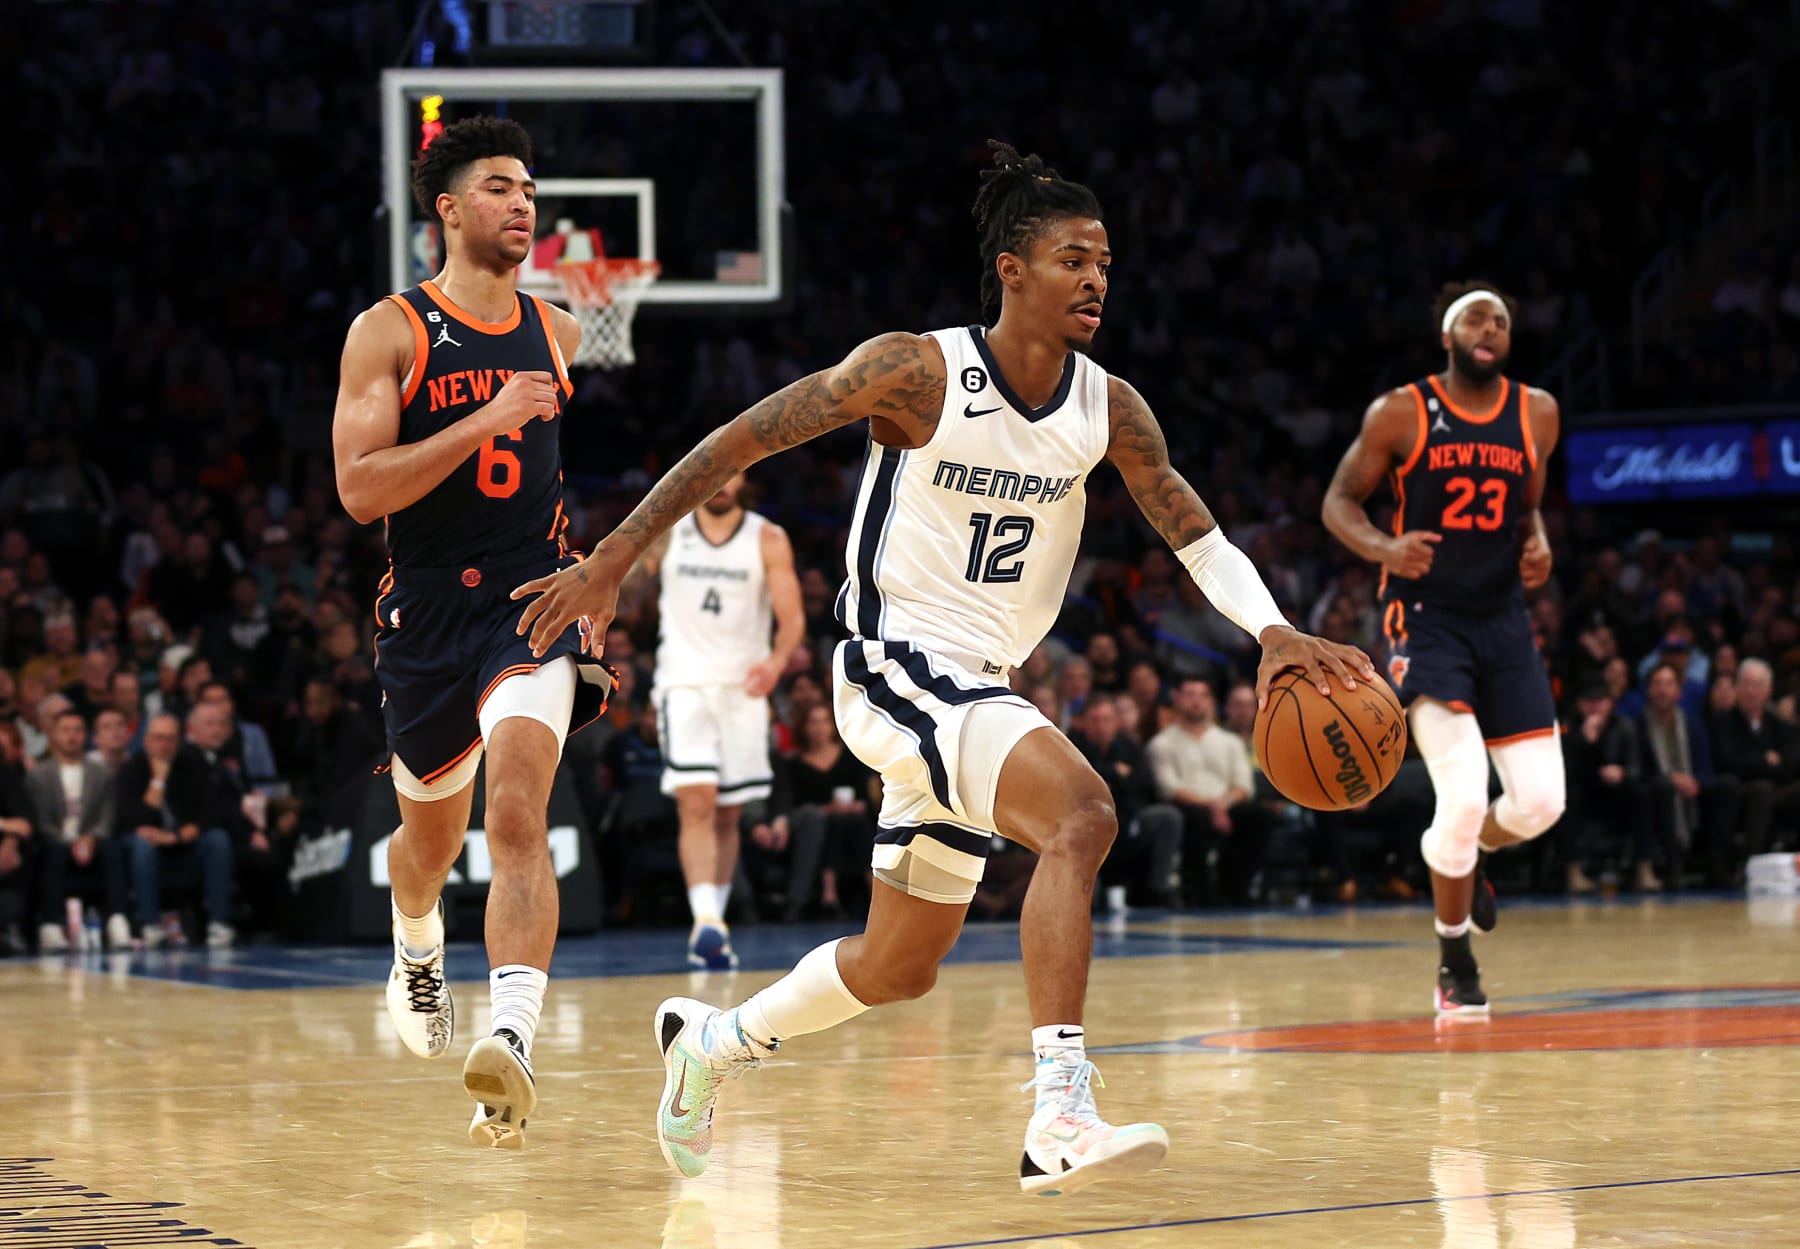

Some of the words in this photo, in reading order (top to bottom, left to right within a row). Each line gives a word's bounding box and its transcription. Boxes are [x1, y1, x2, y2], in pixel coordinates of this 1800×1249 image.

[426, 311, 442, 323] 6
[427, 368, 495, 412] NEW
[965, 369, 983, 391] 6
[476, 427, 523, 499] 6
[1428, 442, 1475, 471] NEW
[1476, 442, 1524, 475] YORK
[1442, 476, 1509, 531] 23
[965, 512, 1034, 583] 12
[701, 586, 722, 617] 4
[1322, 718, 1373, 805] Wilson
